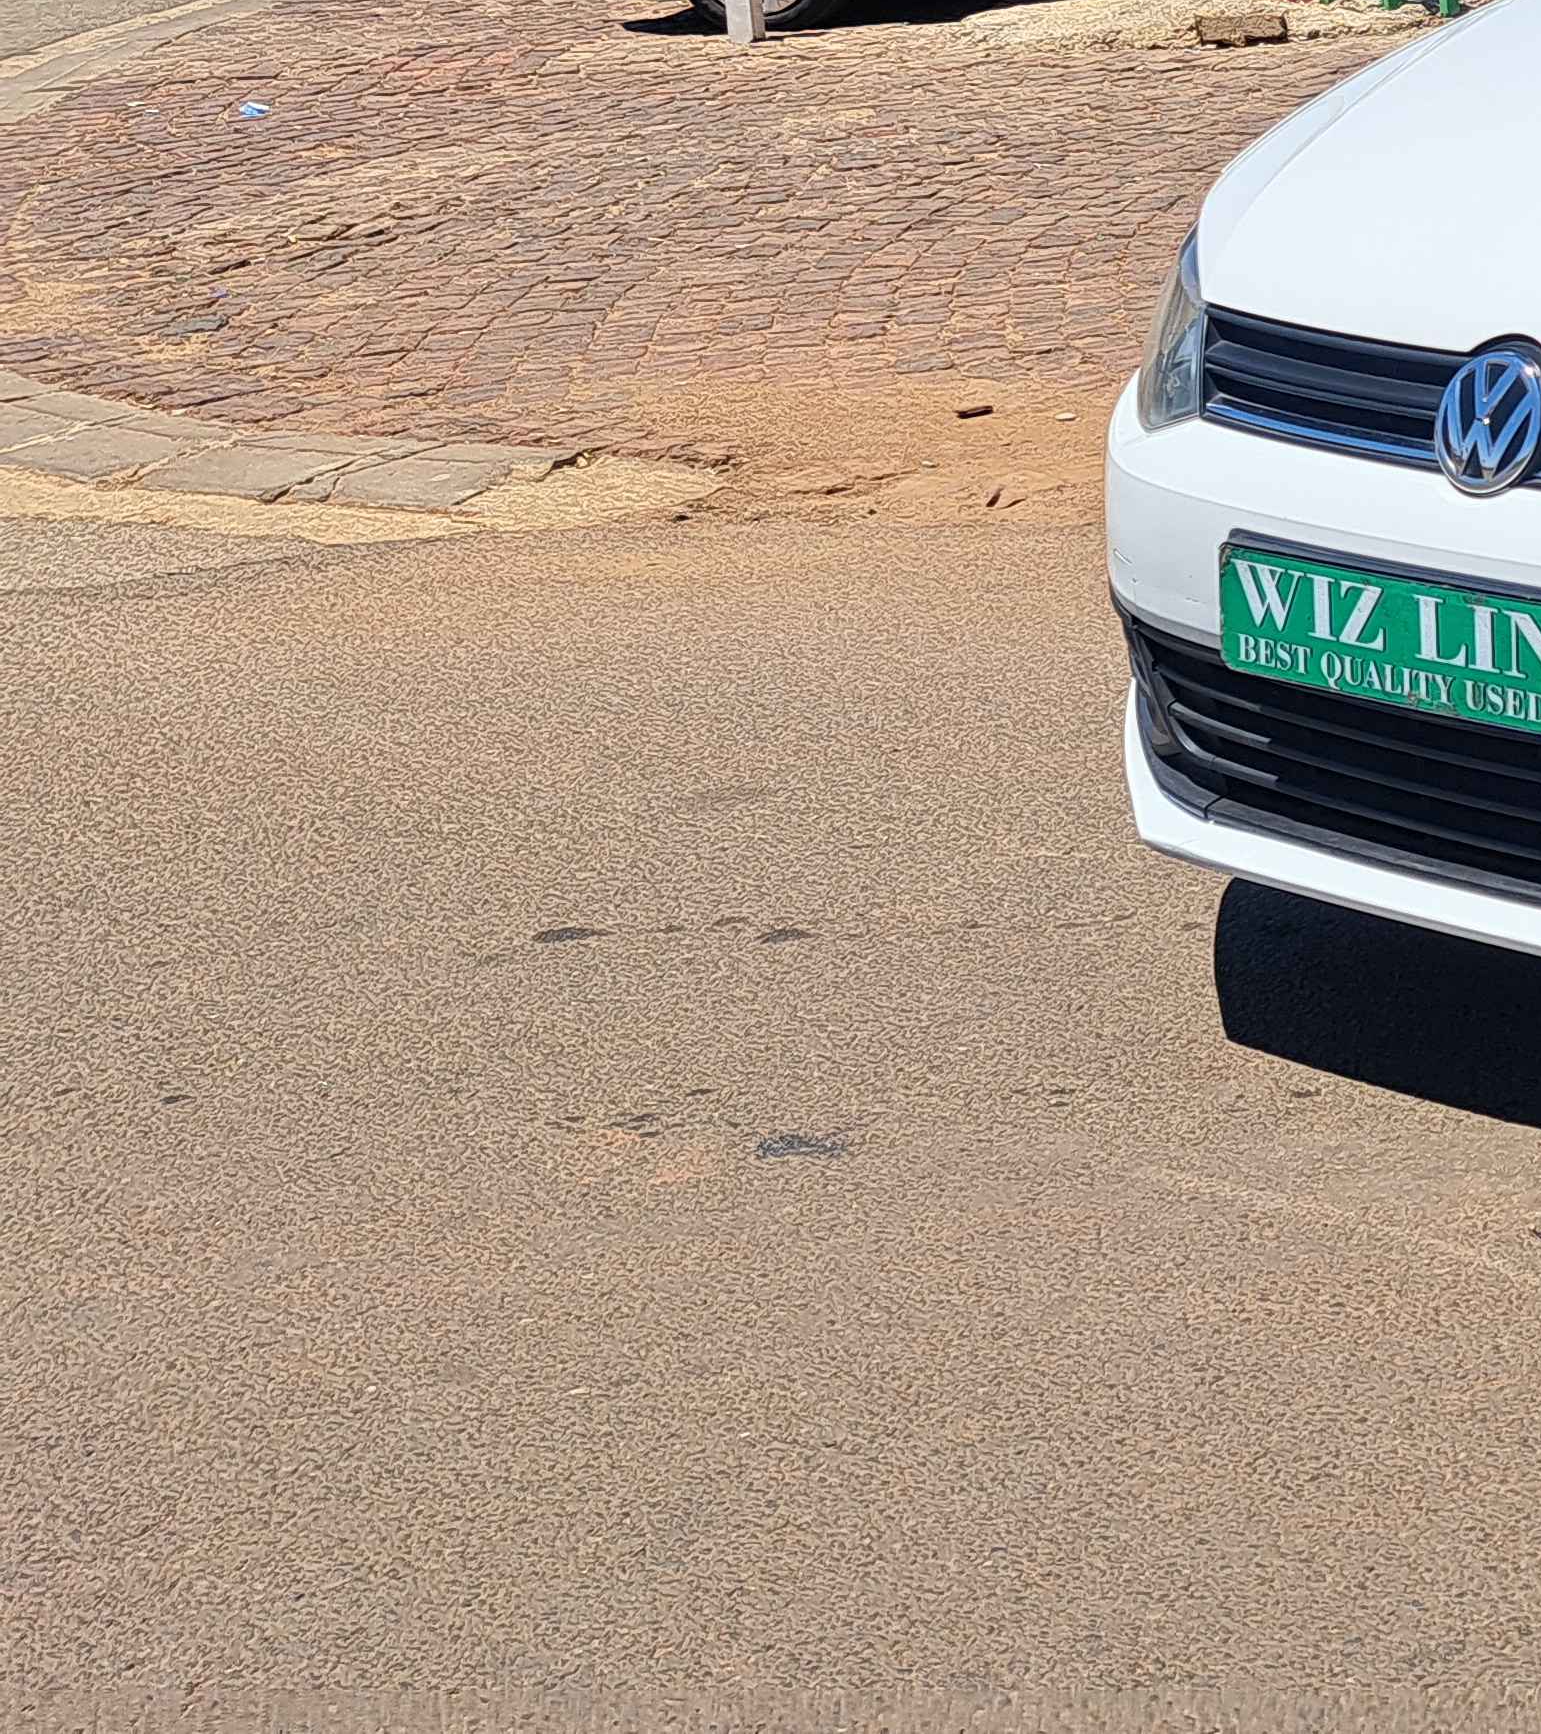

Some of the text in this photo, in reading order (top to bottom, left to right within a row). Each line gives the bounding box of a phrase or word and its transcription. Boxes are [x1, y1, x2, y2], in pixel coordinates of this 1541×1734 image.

[1232, 558, 1388, 652] WIZ
[1237, 633, 1313, 675] BEST
[1320, 651, 1457, 707] QUALITY
